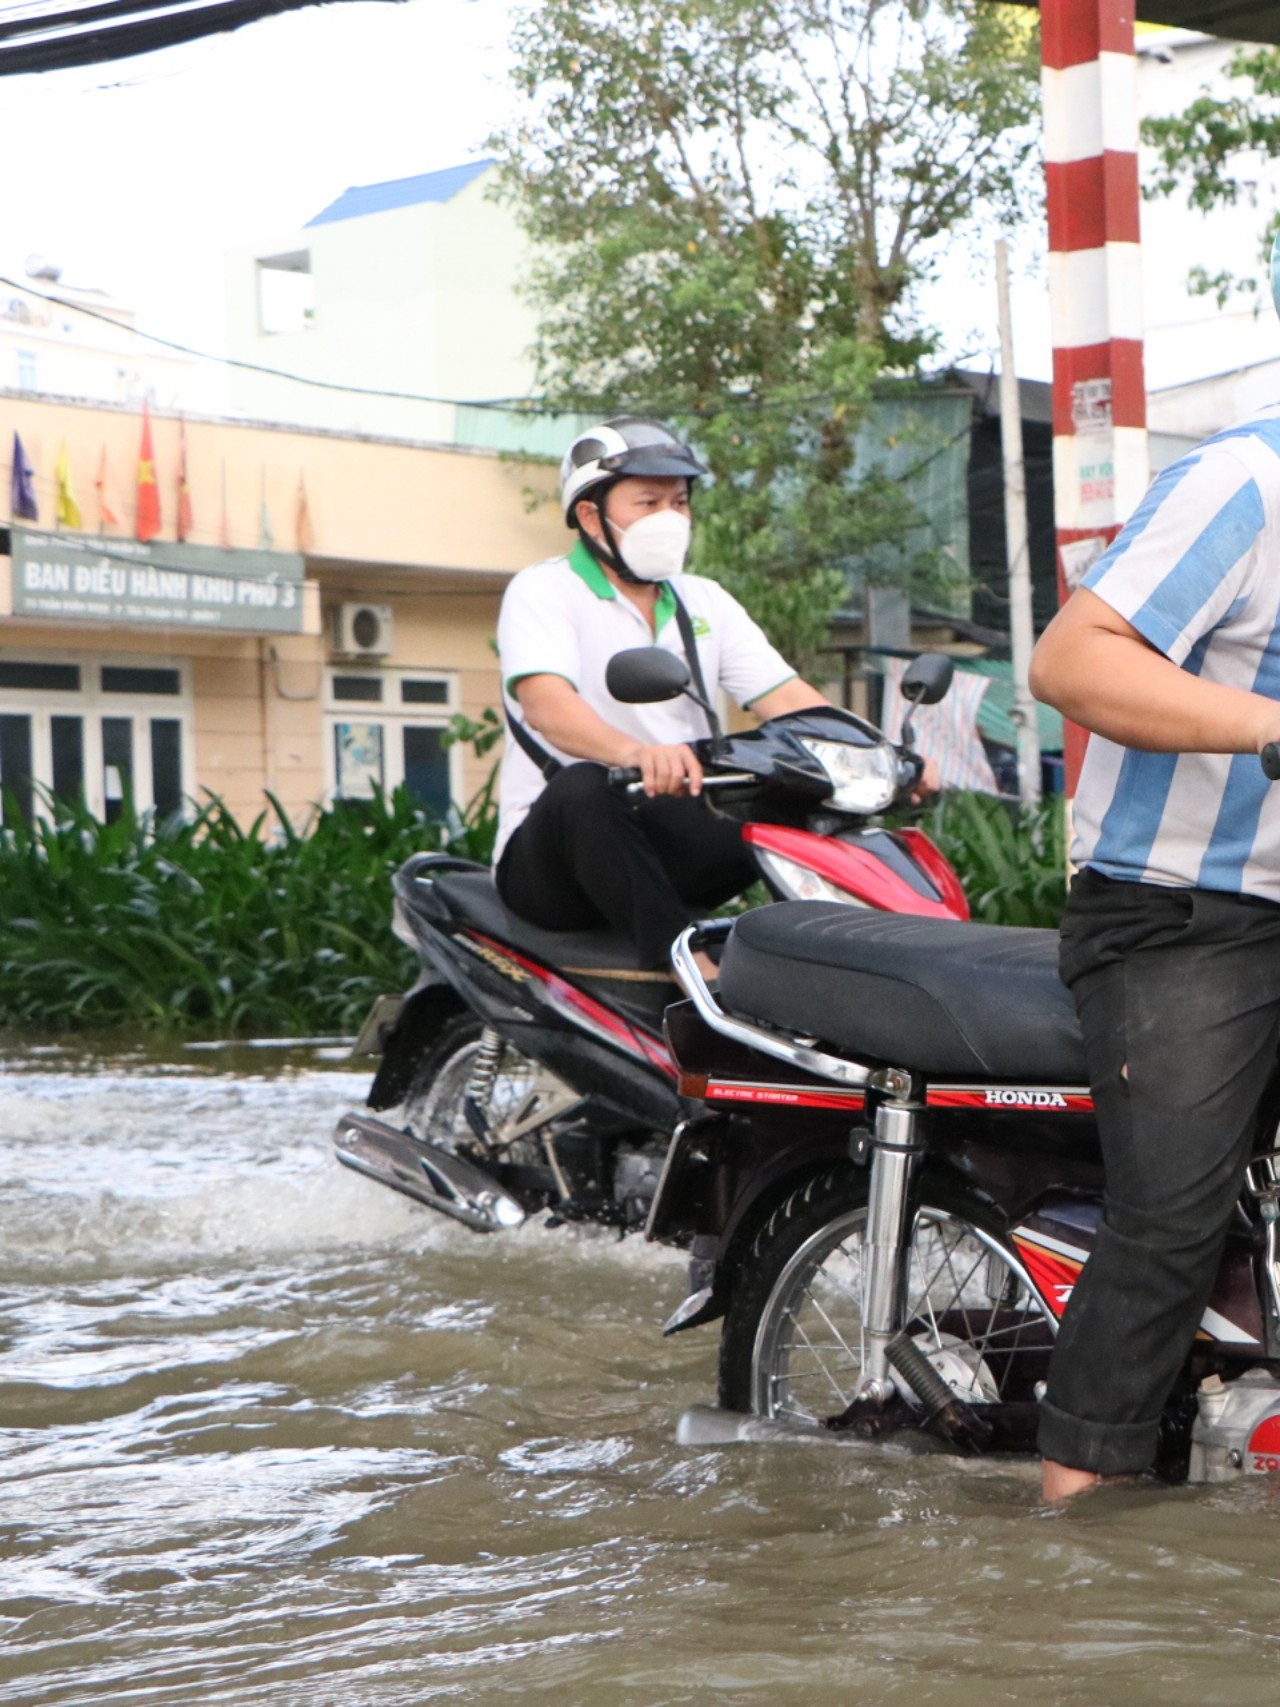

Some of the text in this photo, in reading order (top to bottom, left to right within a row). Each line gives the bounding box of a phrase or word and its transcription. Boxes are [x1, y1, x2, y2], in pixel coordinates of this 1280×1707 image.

[24, 560, 70, 592] BAN
[191, 574, 235, 604] KHU
[713, 1087, 799, 1102] ELECTRIC STARTER
[984, 1090, 1068, 1107] HONDA
